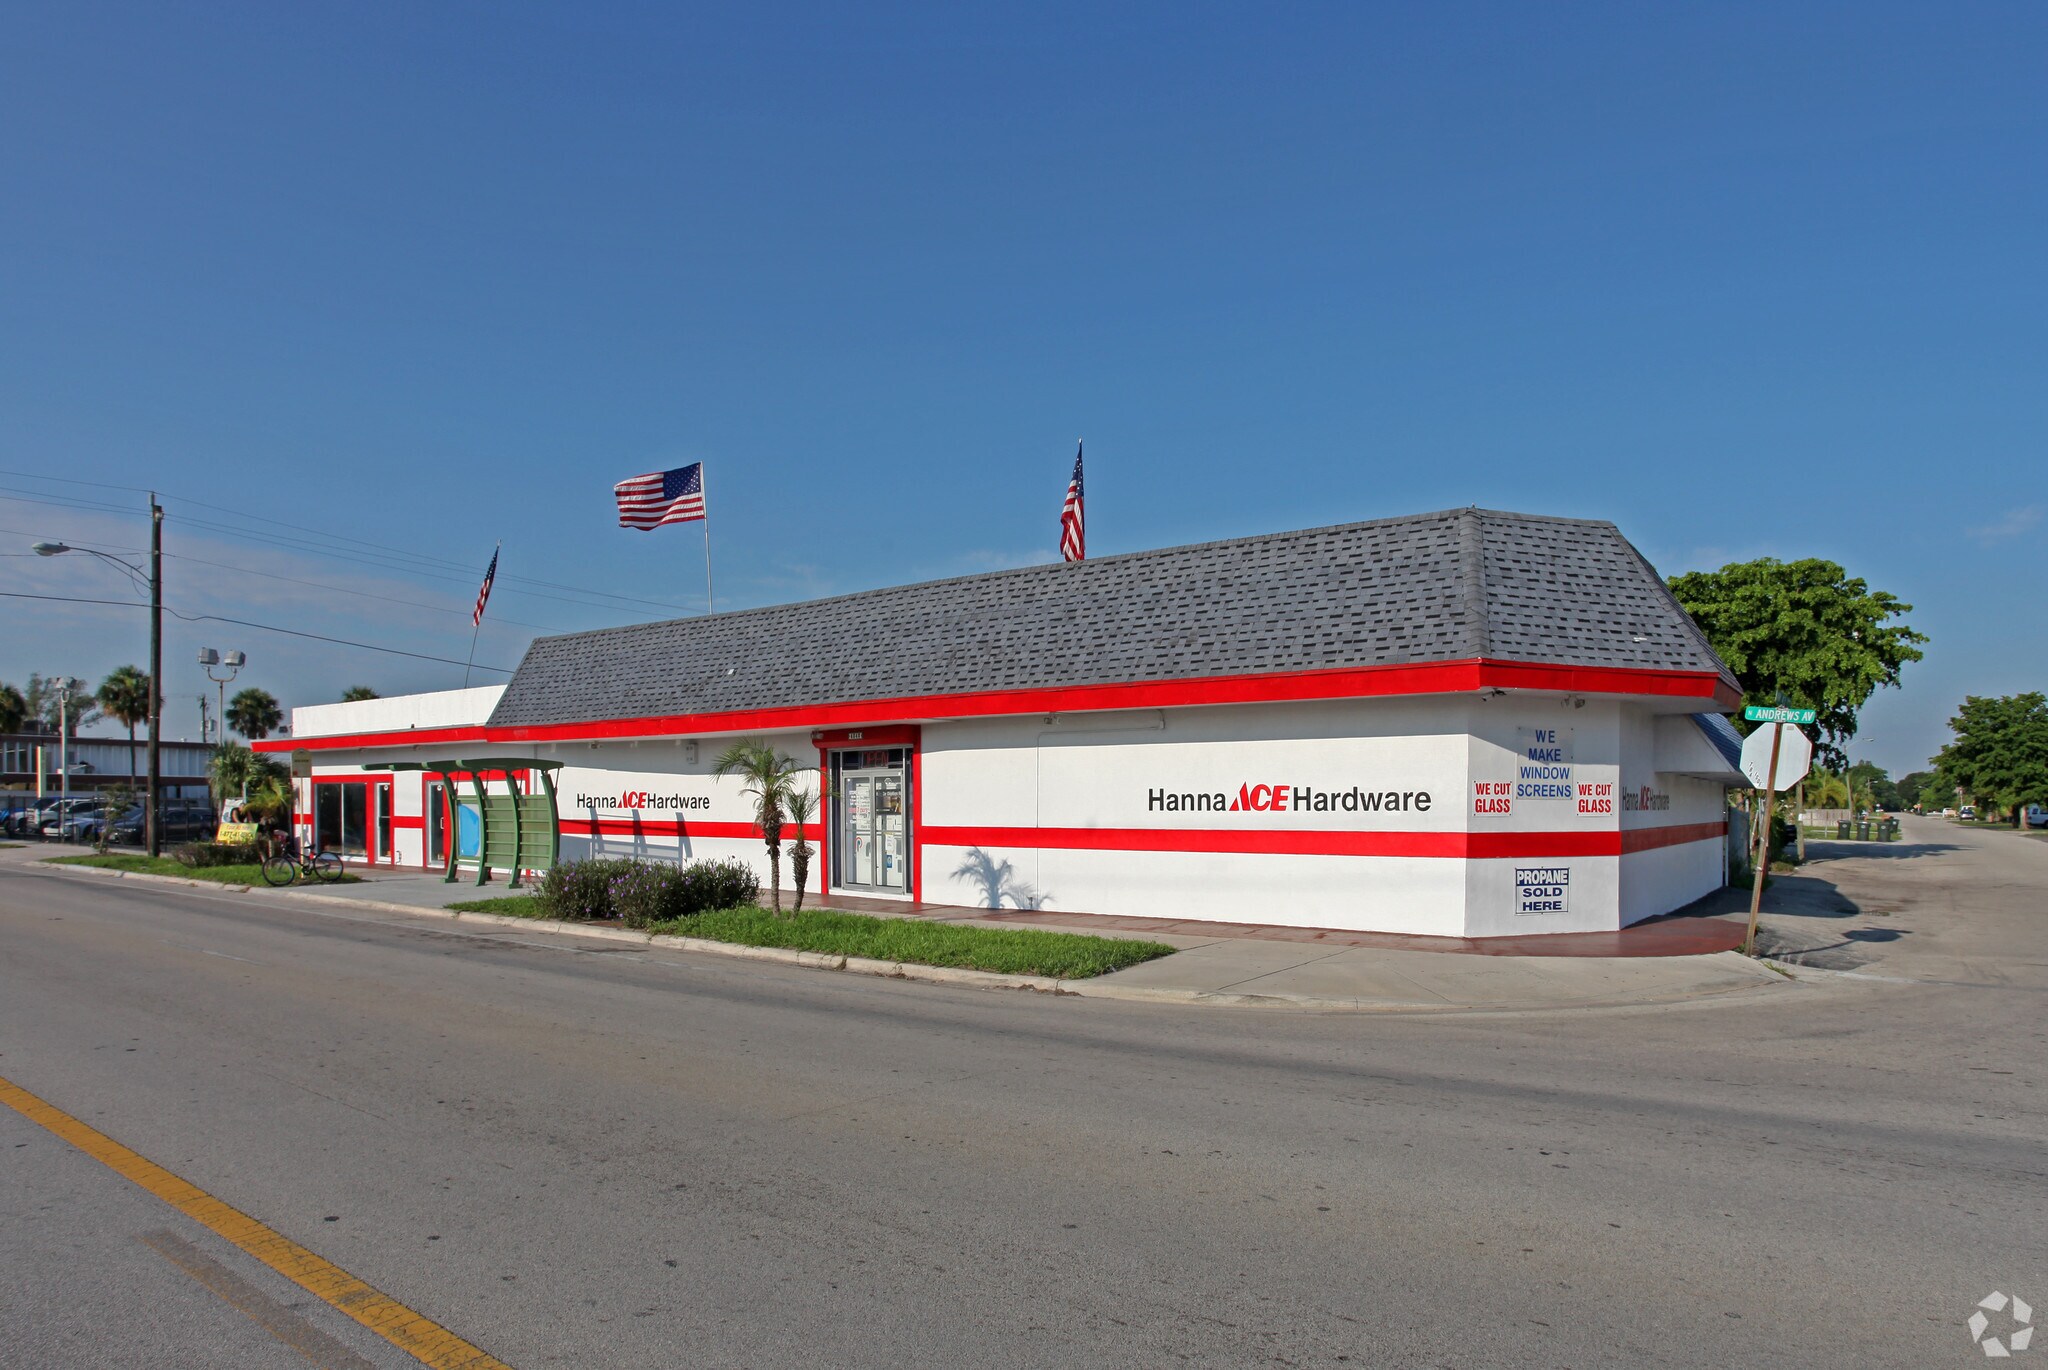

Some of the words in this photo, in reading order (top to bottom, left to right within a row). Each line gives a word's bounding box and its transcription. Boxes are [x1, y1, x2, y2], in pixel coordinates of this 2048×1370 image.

[1755, 709, 1800, 721] ANDREWS
[1801, 711, 1814, 722] AV
[1535, 729, 1556, 743] WE
[1528, 748, 1562, 762] MAKE
[1520, 766, 1570, 780] WINDOW
[1475, 782, 1491, 796] WE
[1493, 782, 1511, 796] CUT
[1516, 783, 1572, 798] SCREENS
[1578, 783, 1593, 796] WE
[1595, 783, 1612, 796] CUT
[576, 793, 617, 809] Hanna
[617, 789, 648, 809] ACE
[647, 793, 710, 809] Hardware
[1148, 788, 1227, 812] Hanna
[1229, 781, 1290, 812] ACE
[1293, 786, 1432, 812] Hardware
[1474, 798, 1511, 813] GLASS
[1578, 798, 1612, 813] GLASS
[1516, 869, 1568, 885] PROPANE
[1522, 887, 1563, 898] SOLD
[1522, 900, 1563, 911] HERE
